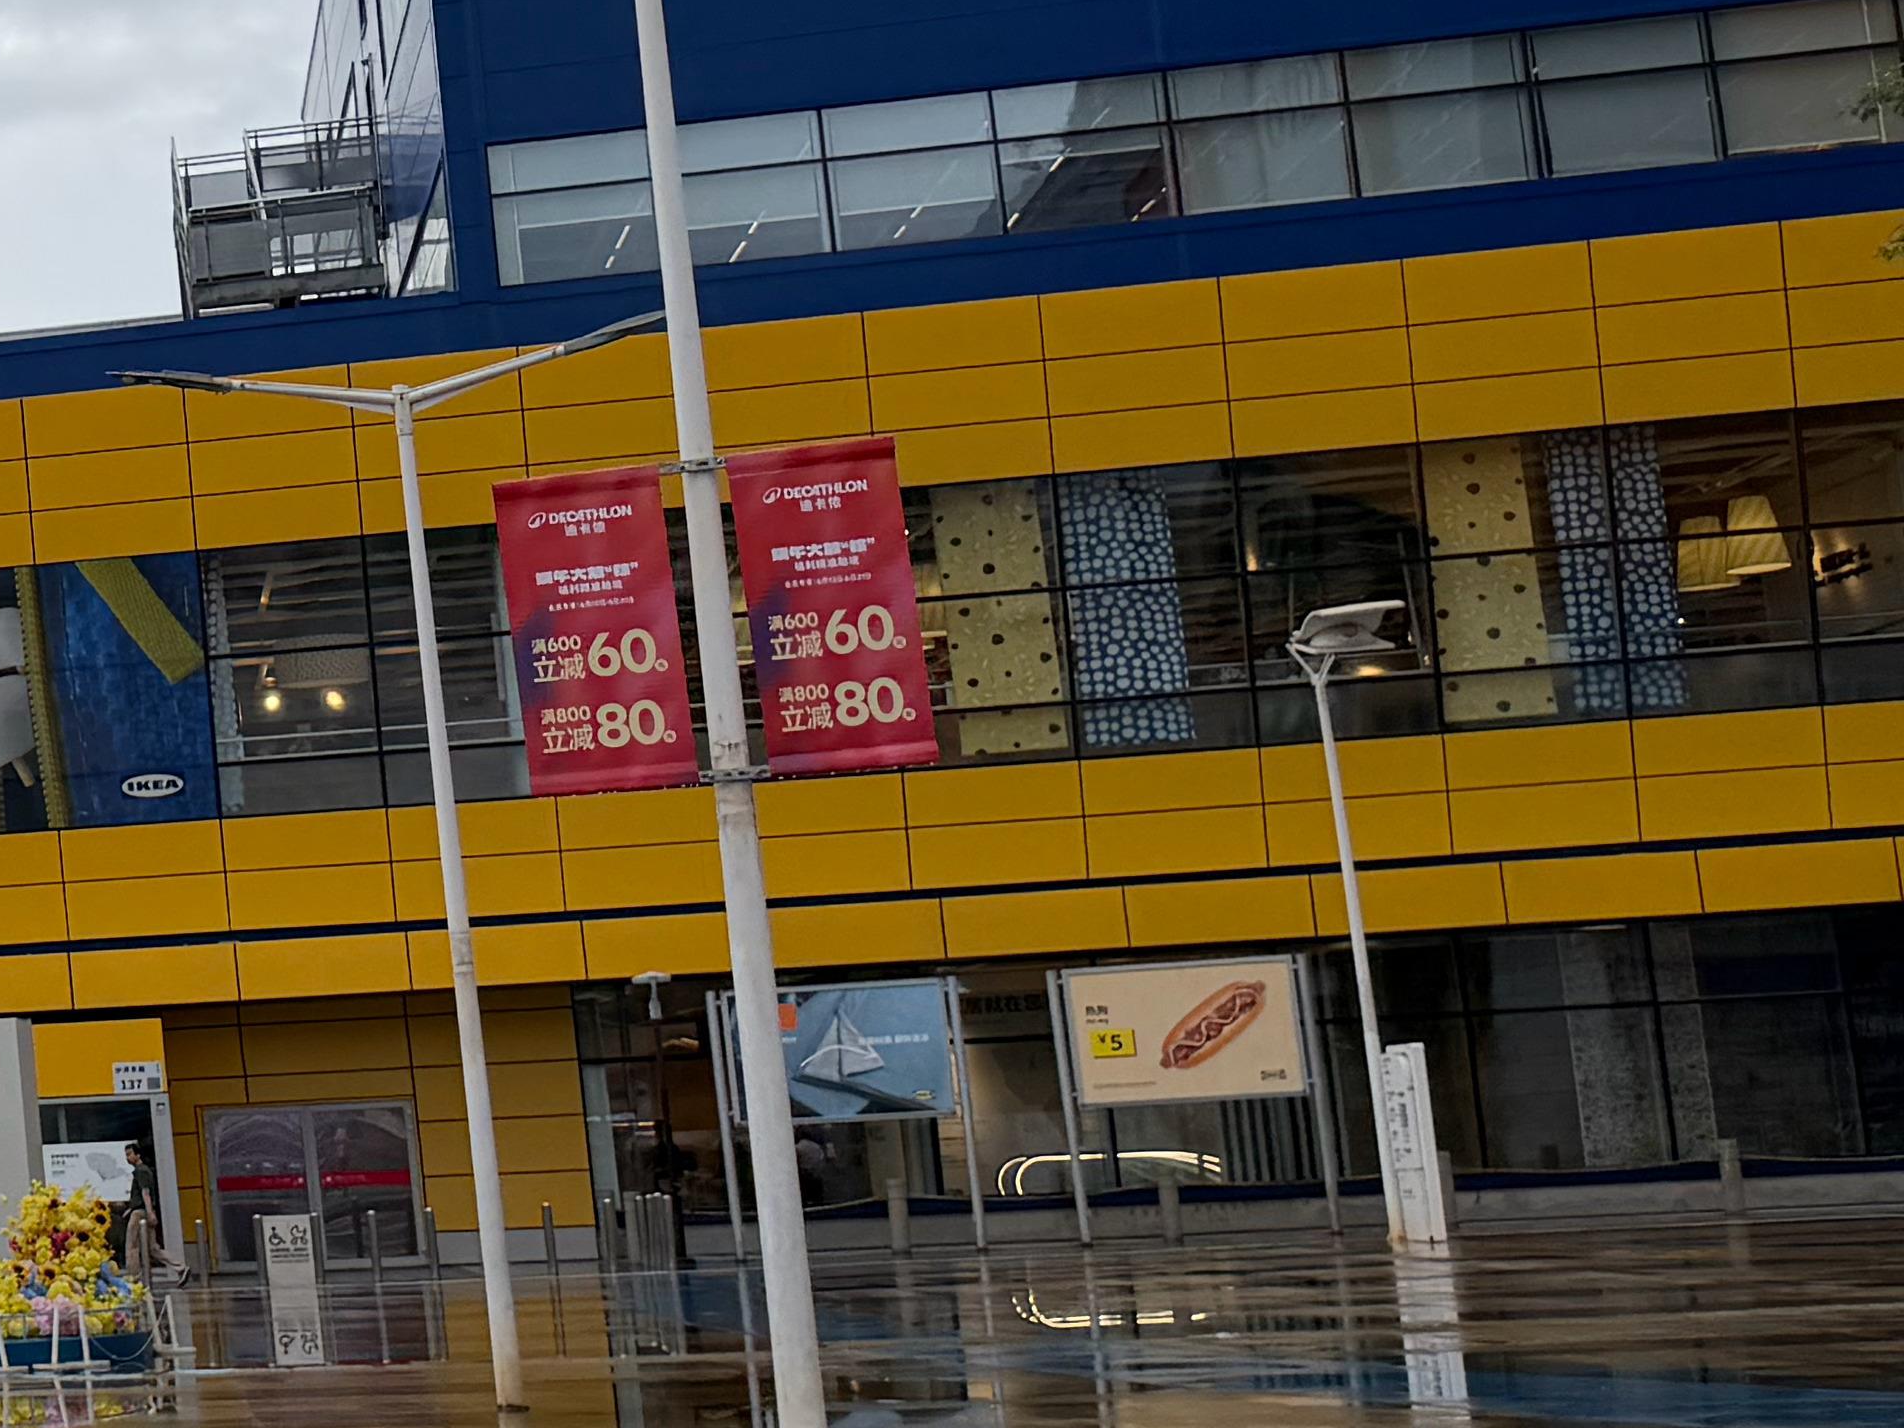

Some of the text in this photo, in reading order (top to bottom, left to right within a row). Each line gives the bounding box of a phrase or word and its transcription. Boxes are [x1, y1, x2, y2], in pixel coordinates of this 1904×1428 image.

[783, 478, 868, 500] DECATHLON
[548, 505, 632, 525] DECATHLON
[768, 611, 818, 631] 满600
[531, 635, 581, 655] 满600
[770, 630, 824, 660] 立减
[533, 653, 586, 683] 立减
[779, 683, 829, 703] 满800
[541, 705, 591, 725] 满800
[780, 701, 834, 733] 立减
[542, 723, 595, 754] 立减
[127, 779, 179, 792] IKEA
